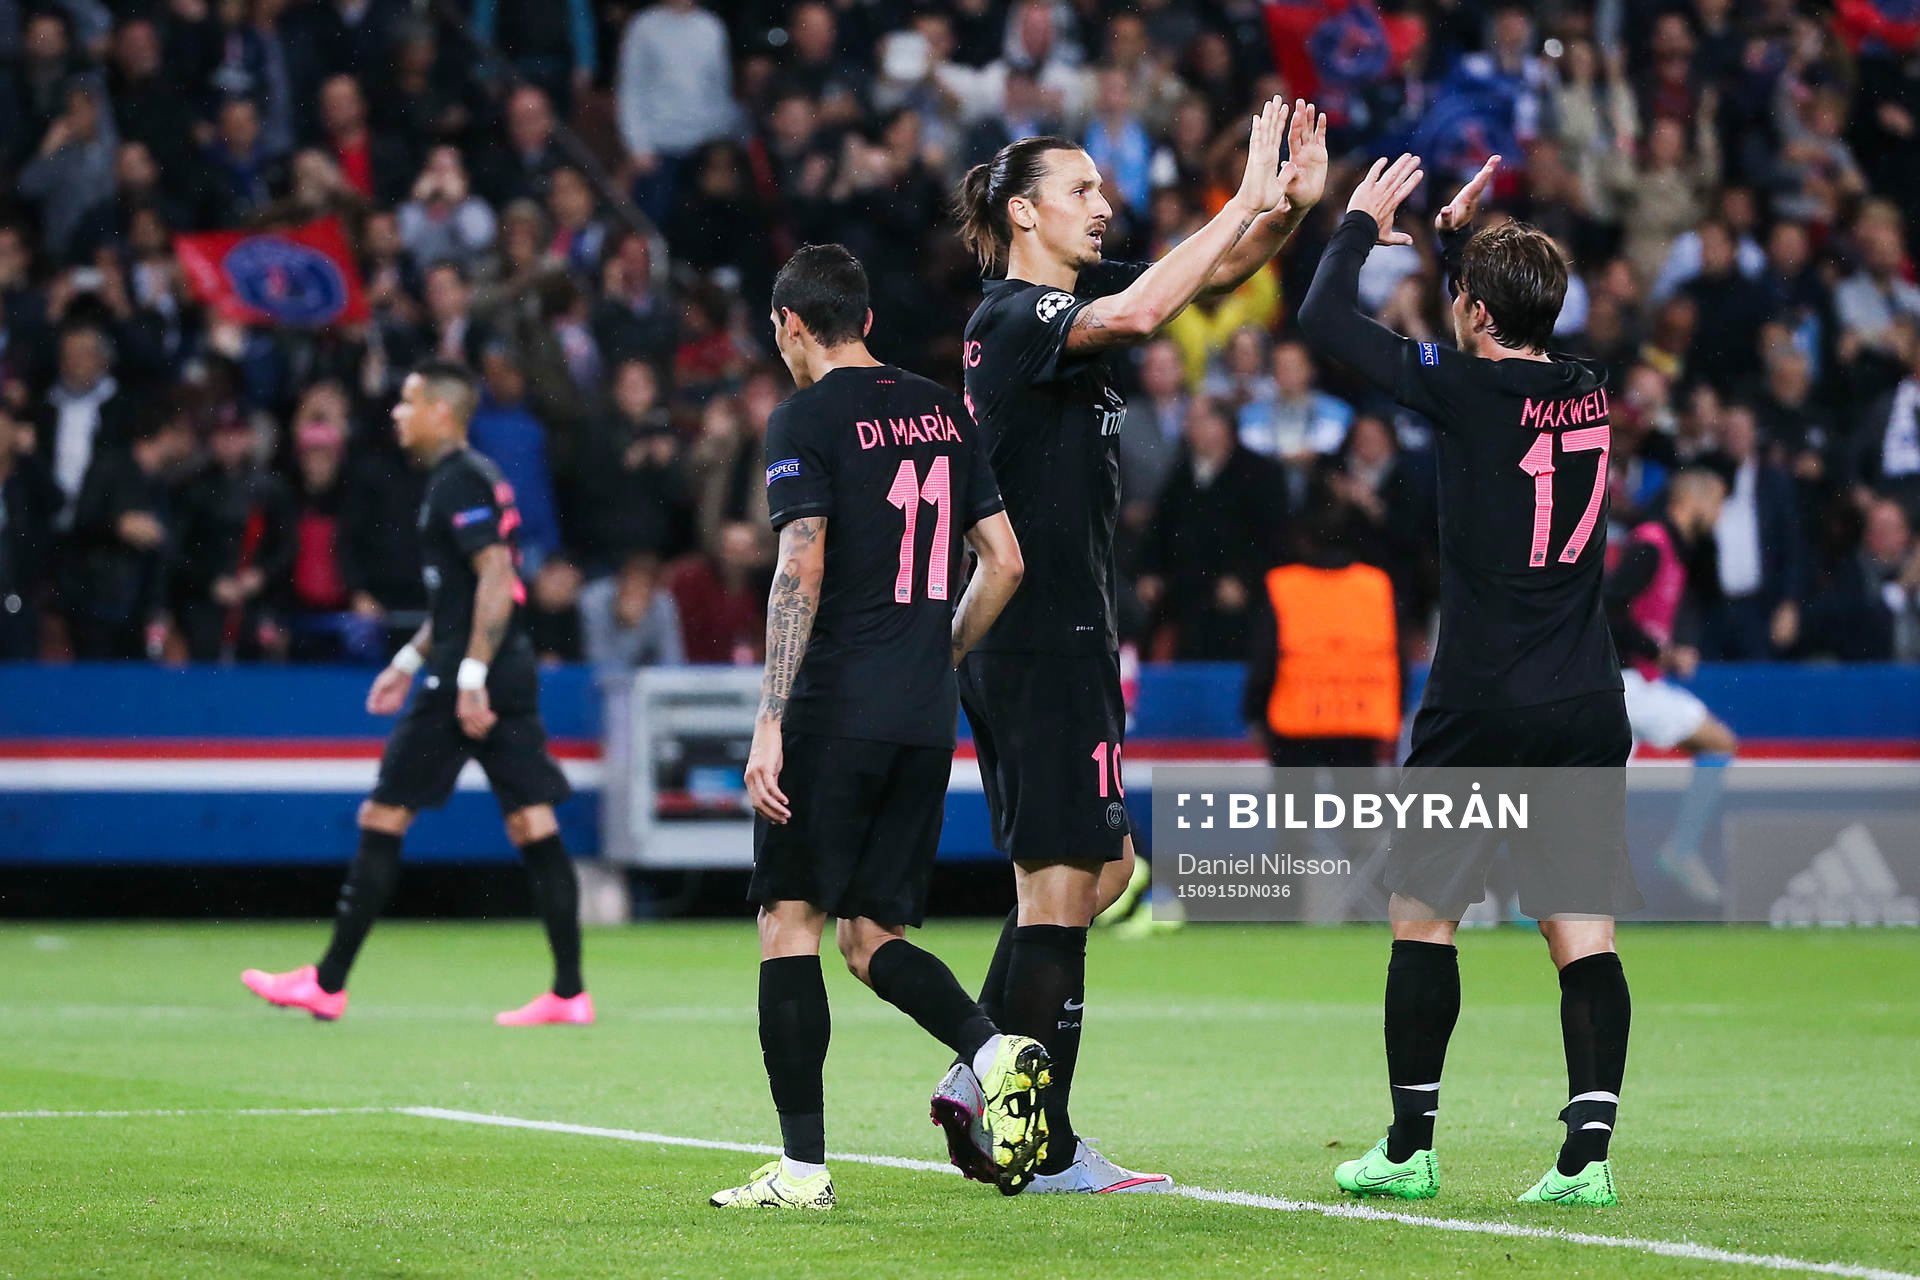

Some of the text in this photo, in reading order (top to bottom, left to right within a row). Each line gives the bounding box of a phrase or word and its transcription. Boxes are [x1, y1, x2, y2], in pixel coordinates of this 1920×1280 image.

[1423, 343, 1434, 366] SPECT
[855, 419, 886, 450] DI
[888, 404, 963, 446] MARÍA
[1520, 387, 1609, 428] MAXWELL
[1518, 424, 1610, 568] 17
[886, 455, 950, 604] 11
